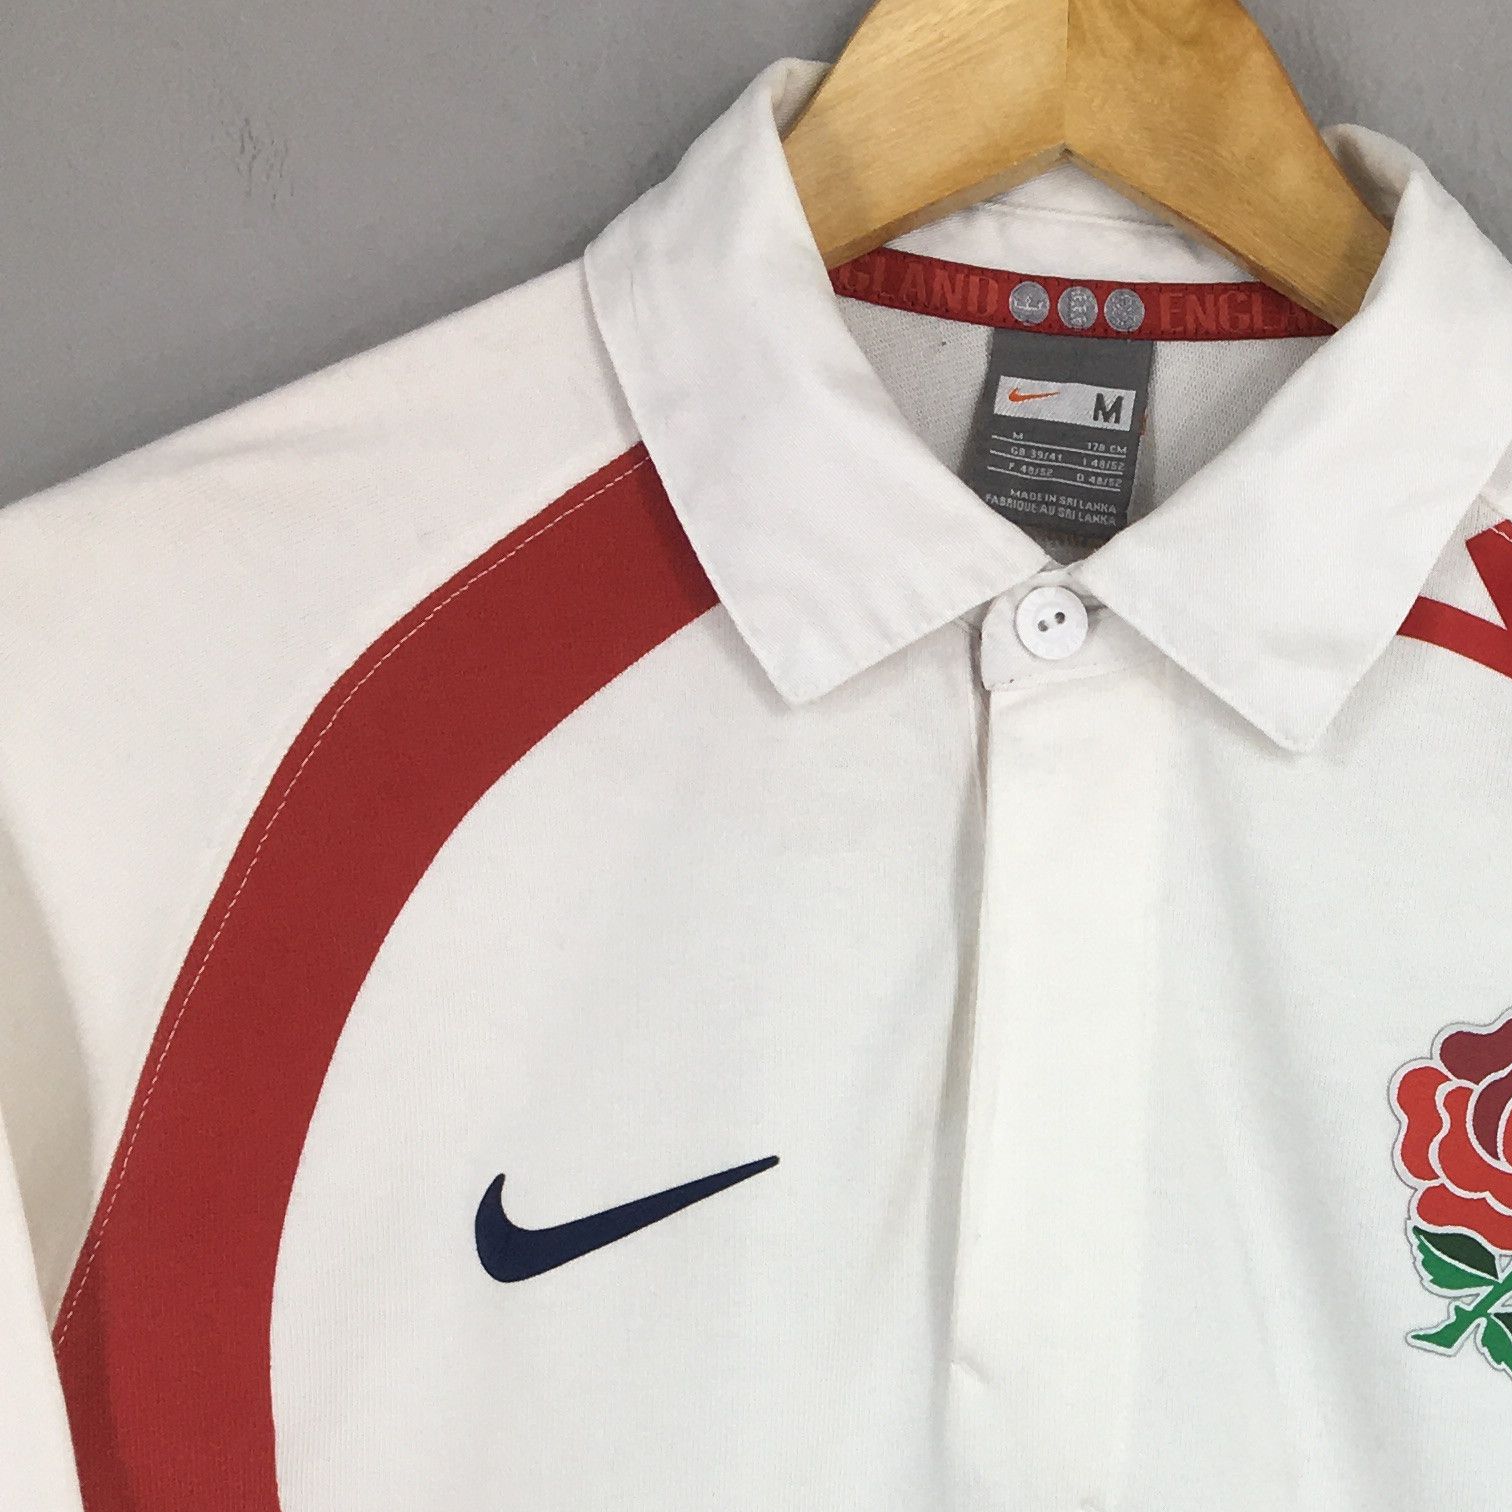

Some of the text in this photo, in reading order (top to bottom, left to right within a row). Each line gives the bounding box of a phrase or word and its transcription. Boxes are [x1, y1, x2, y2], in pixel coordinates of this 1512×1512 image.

[1093, 392, 1124, 424] M
[1012, 432, 1024, 440] M
[1011, 446, 1026, 456] GB
[1109, 445, 1127, 454] CM
[1008, 462, 1016, 470] F
[984, 493, 1117, 527] FABRIQUE AU SRI LANKA
[1059, 495, 1077, 508] SRI
[1079, 498, 1117, 515] LANKA
